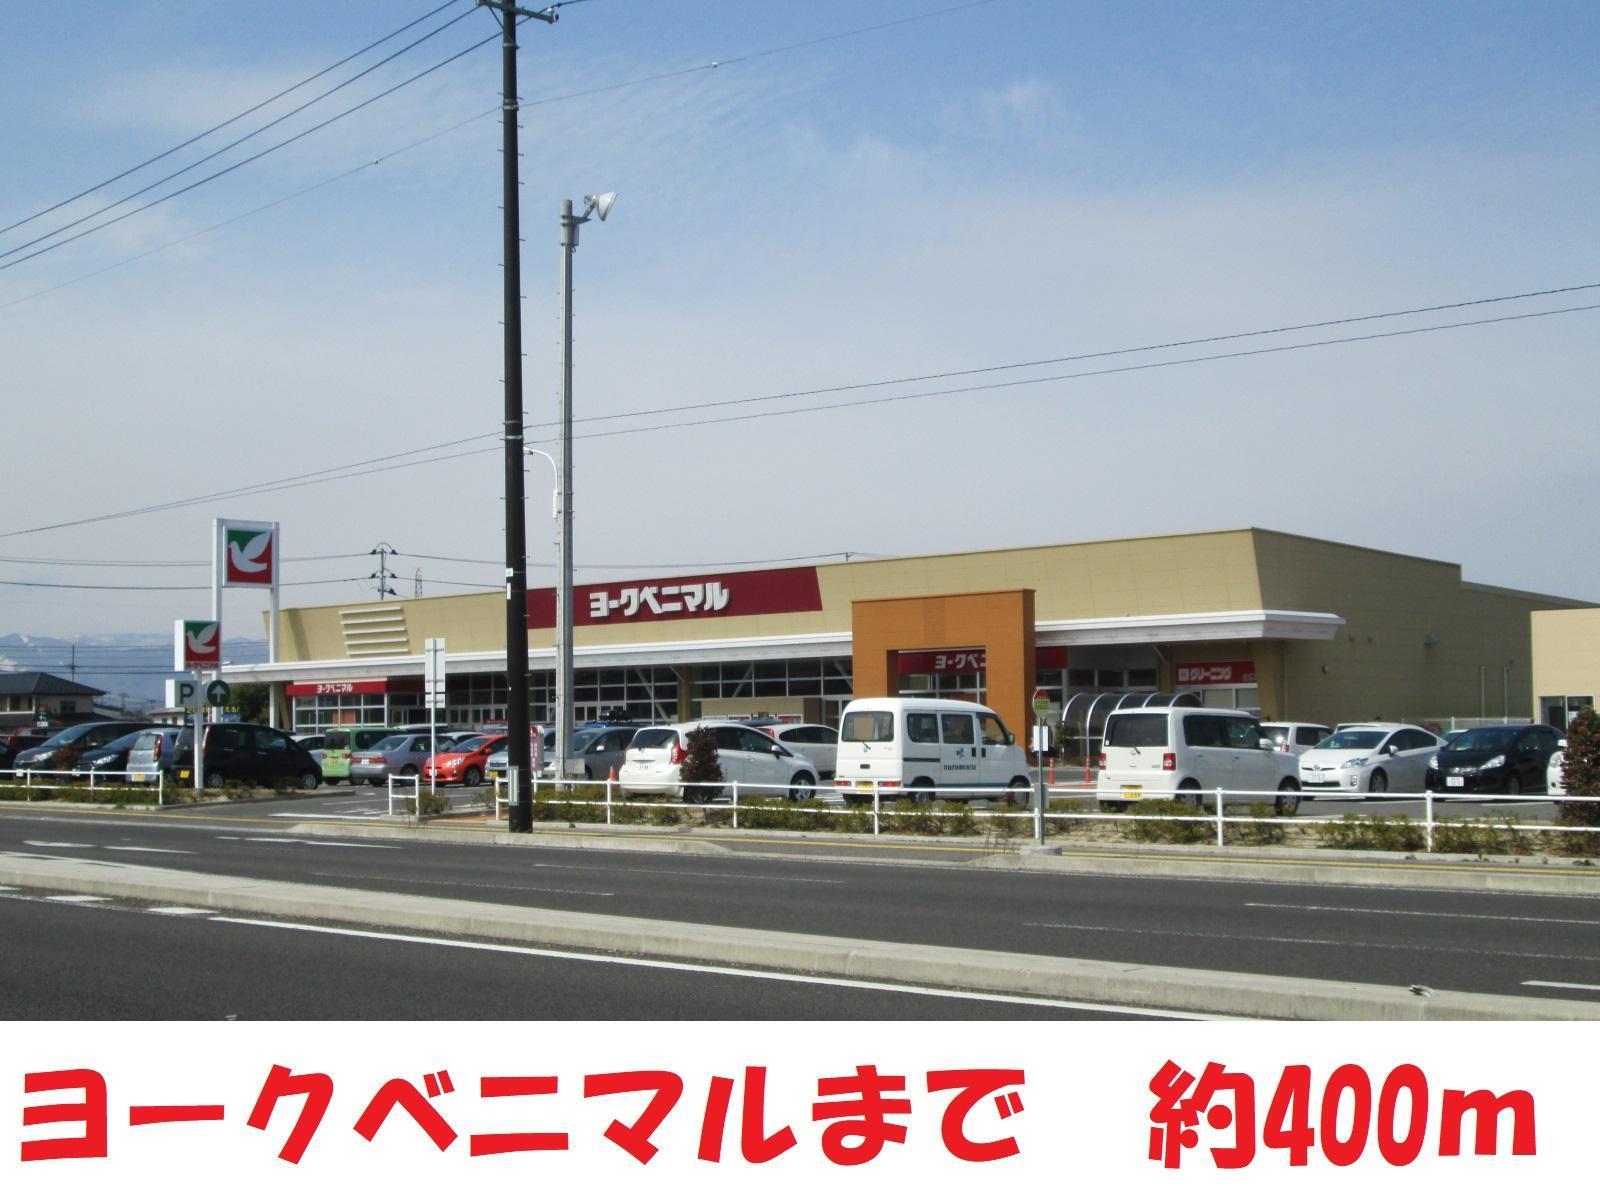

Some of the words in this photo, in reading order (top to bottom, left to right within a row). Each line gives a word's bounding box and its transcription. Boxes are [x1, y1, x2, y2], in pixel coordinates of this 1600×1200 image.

[589, 582, 729, 618] ヨークベニマル
[180, 683, 195, 705] P
[316, 683, 353, 694] ヨークベニマル
